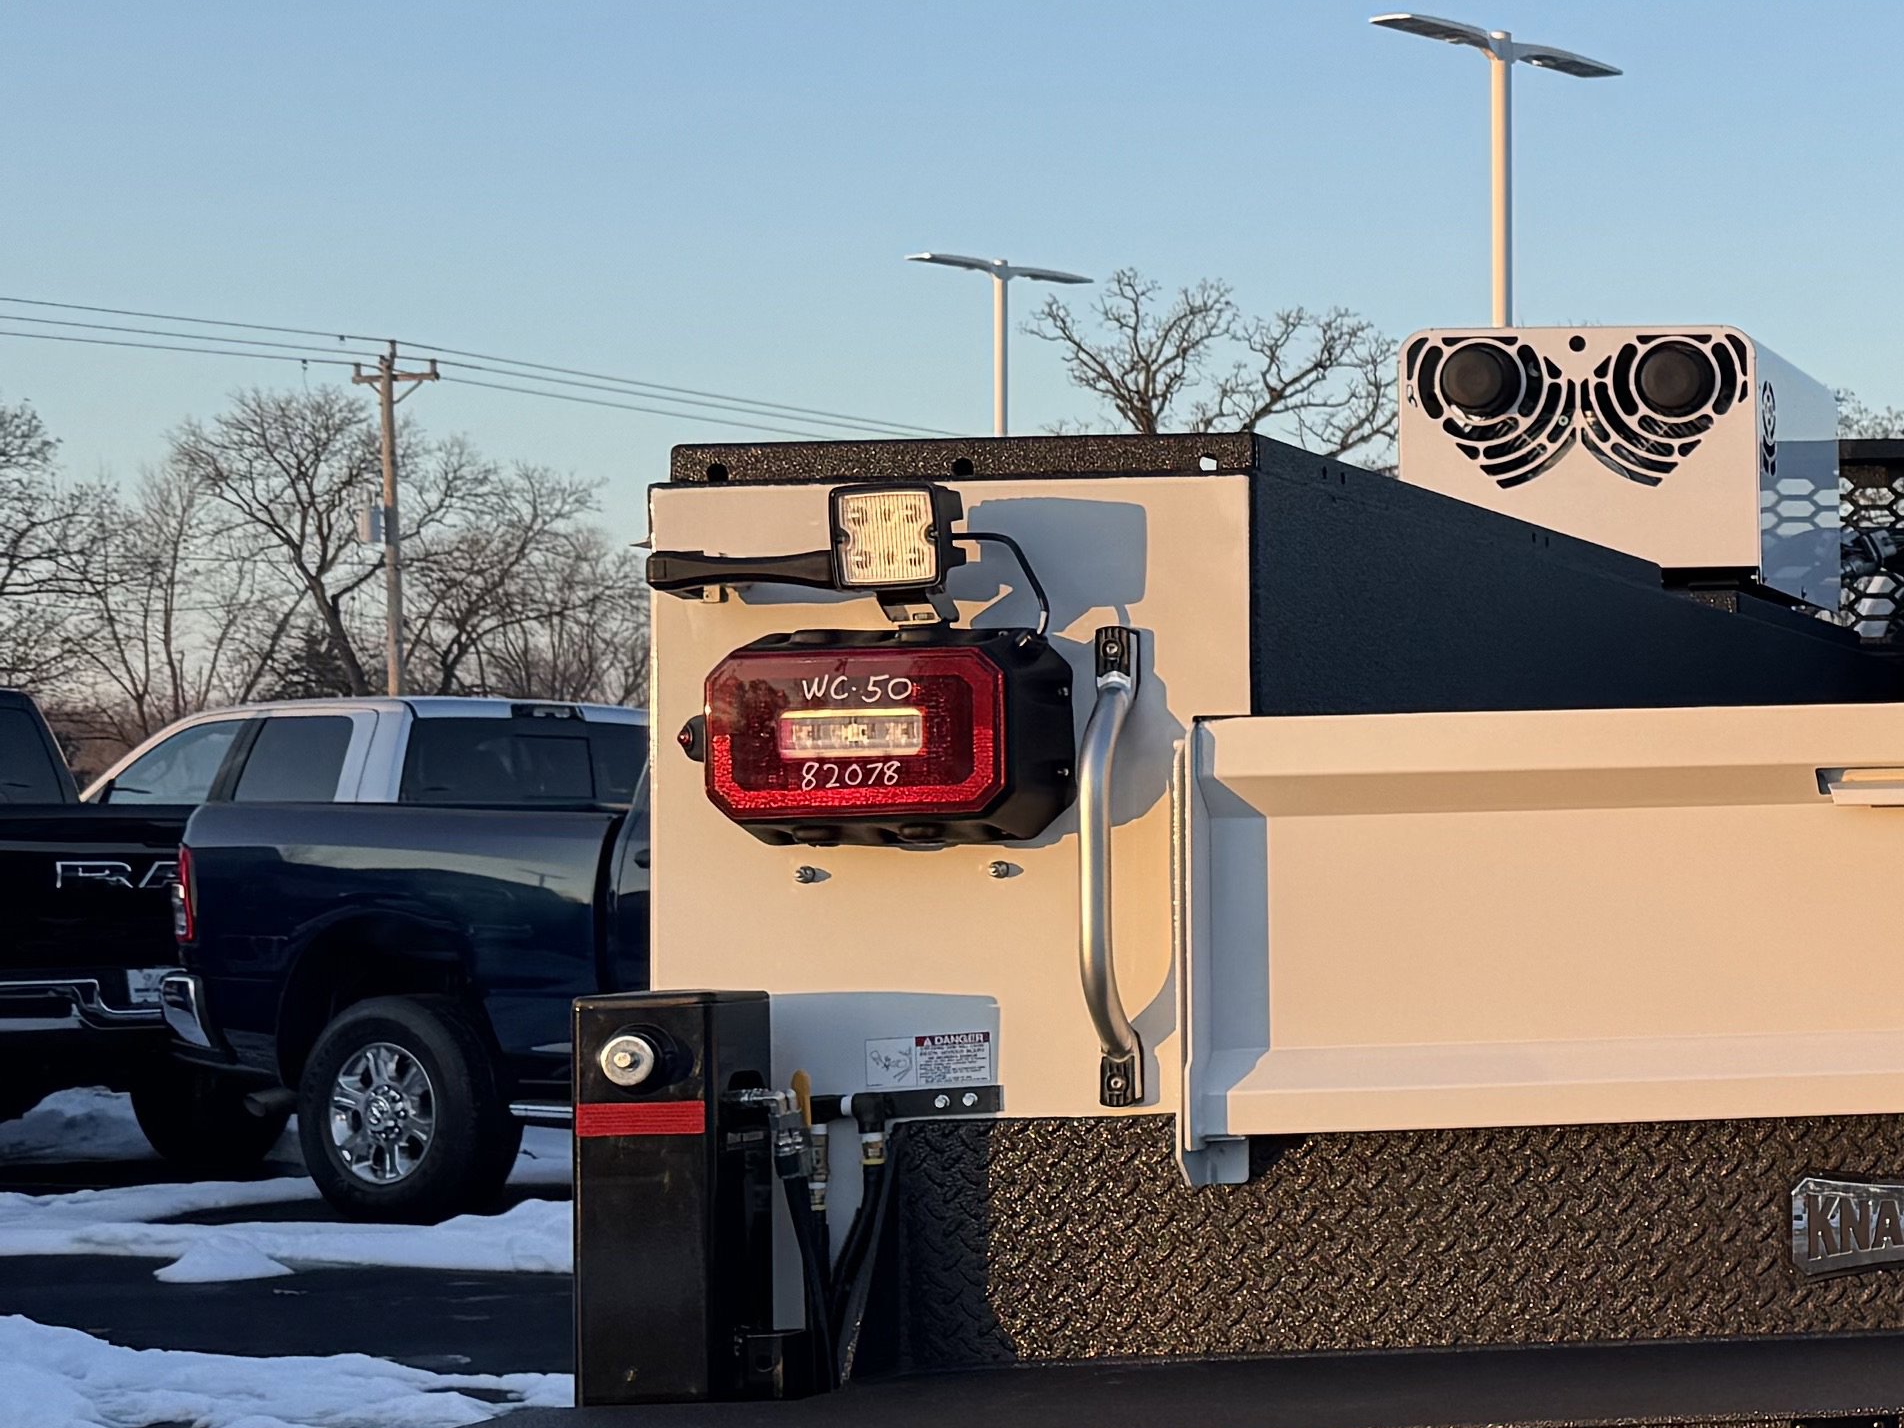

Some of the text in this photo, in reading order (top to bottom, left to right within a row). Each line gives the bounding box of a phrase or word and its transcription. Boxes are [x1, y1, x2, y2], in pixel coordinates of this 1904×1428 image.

[801, 760, 901, 791] 82078
[55, 860, 182, 889] RA
[934, 1033, 984, 1045] DANGER
